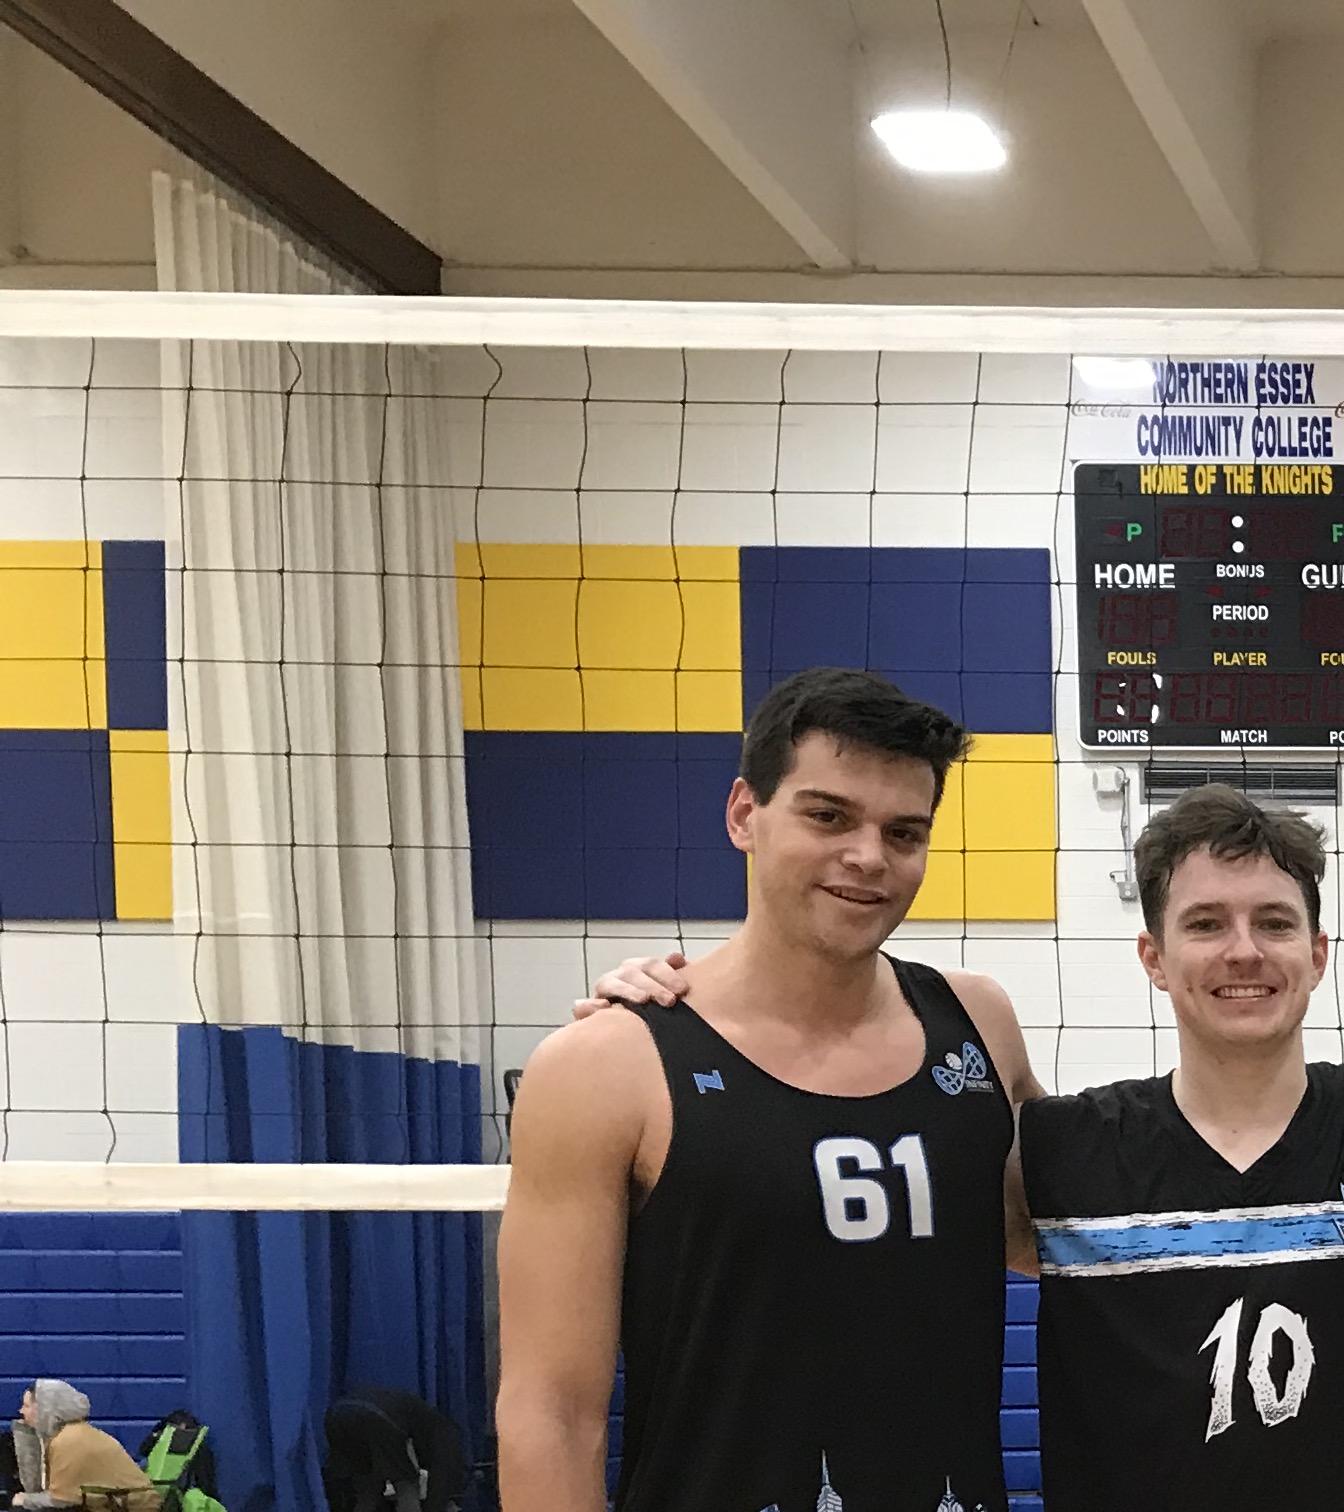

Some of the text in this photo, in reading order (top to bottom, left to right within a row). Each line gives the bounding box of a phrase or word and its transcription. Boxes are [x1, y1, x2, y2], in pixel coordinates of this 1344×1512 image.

[1152, 362, 1315, 404] NORTHERN ESSEX
[1137, 415, 1334, 458] COMMUNITY COLLEGE
[1140, 464, 1333, 495] HOME OF THE KNIGHTS
[1126, 522, 1142, 541] P
[1094, 563, 1176, 589] HOME
[1216, 564, 1265, 578] BONUS
[1212, 605, 1269, 621] PERIOD
[1107, 651, 1157, 665] FOULS
[1213, 652, 1268, 666] PLAYER
[1098, 730, 1149, 743] POINTS
[1220, 729, 1268, 743] MATCH
[812, 1132, 935, 1243] 61
[1198, 1296, 1316, 1443] 10
